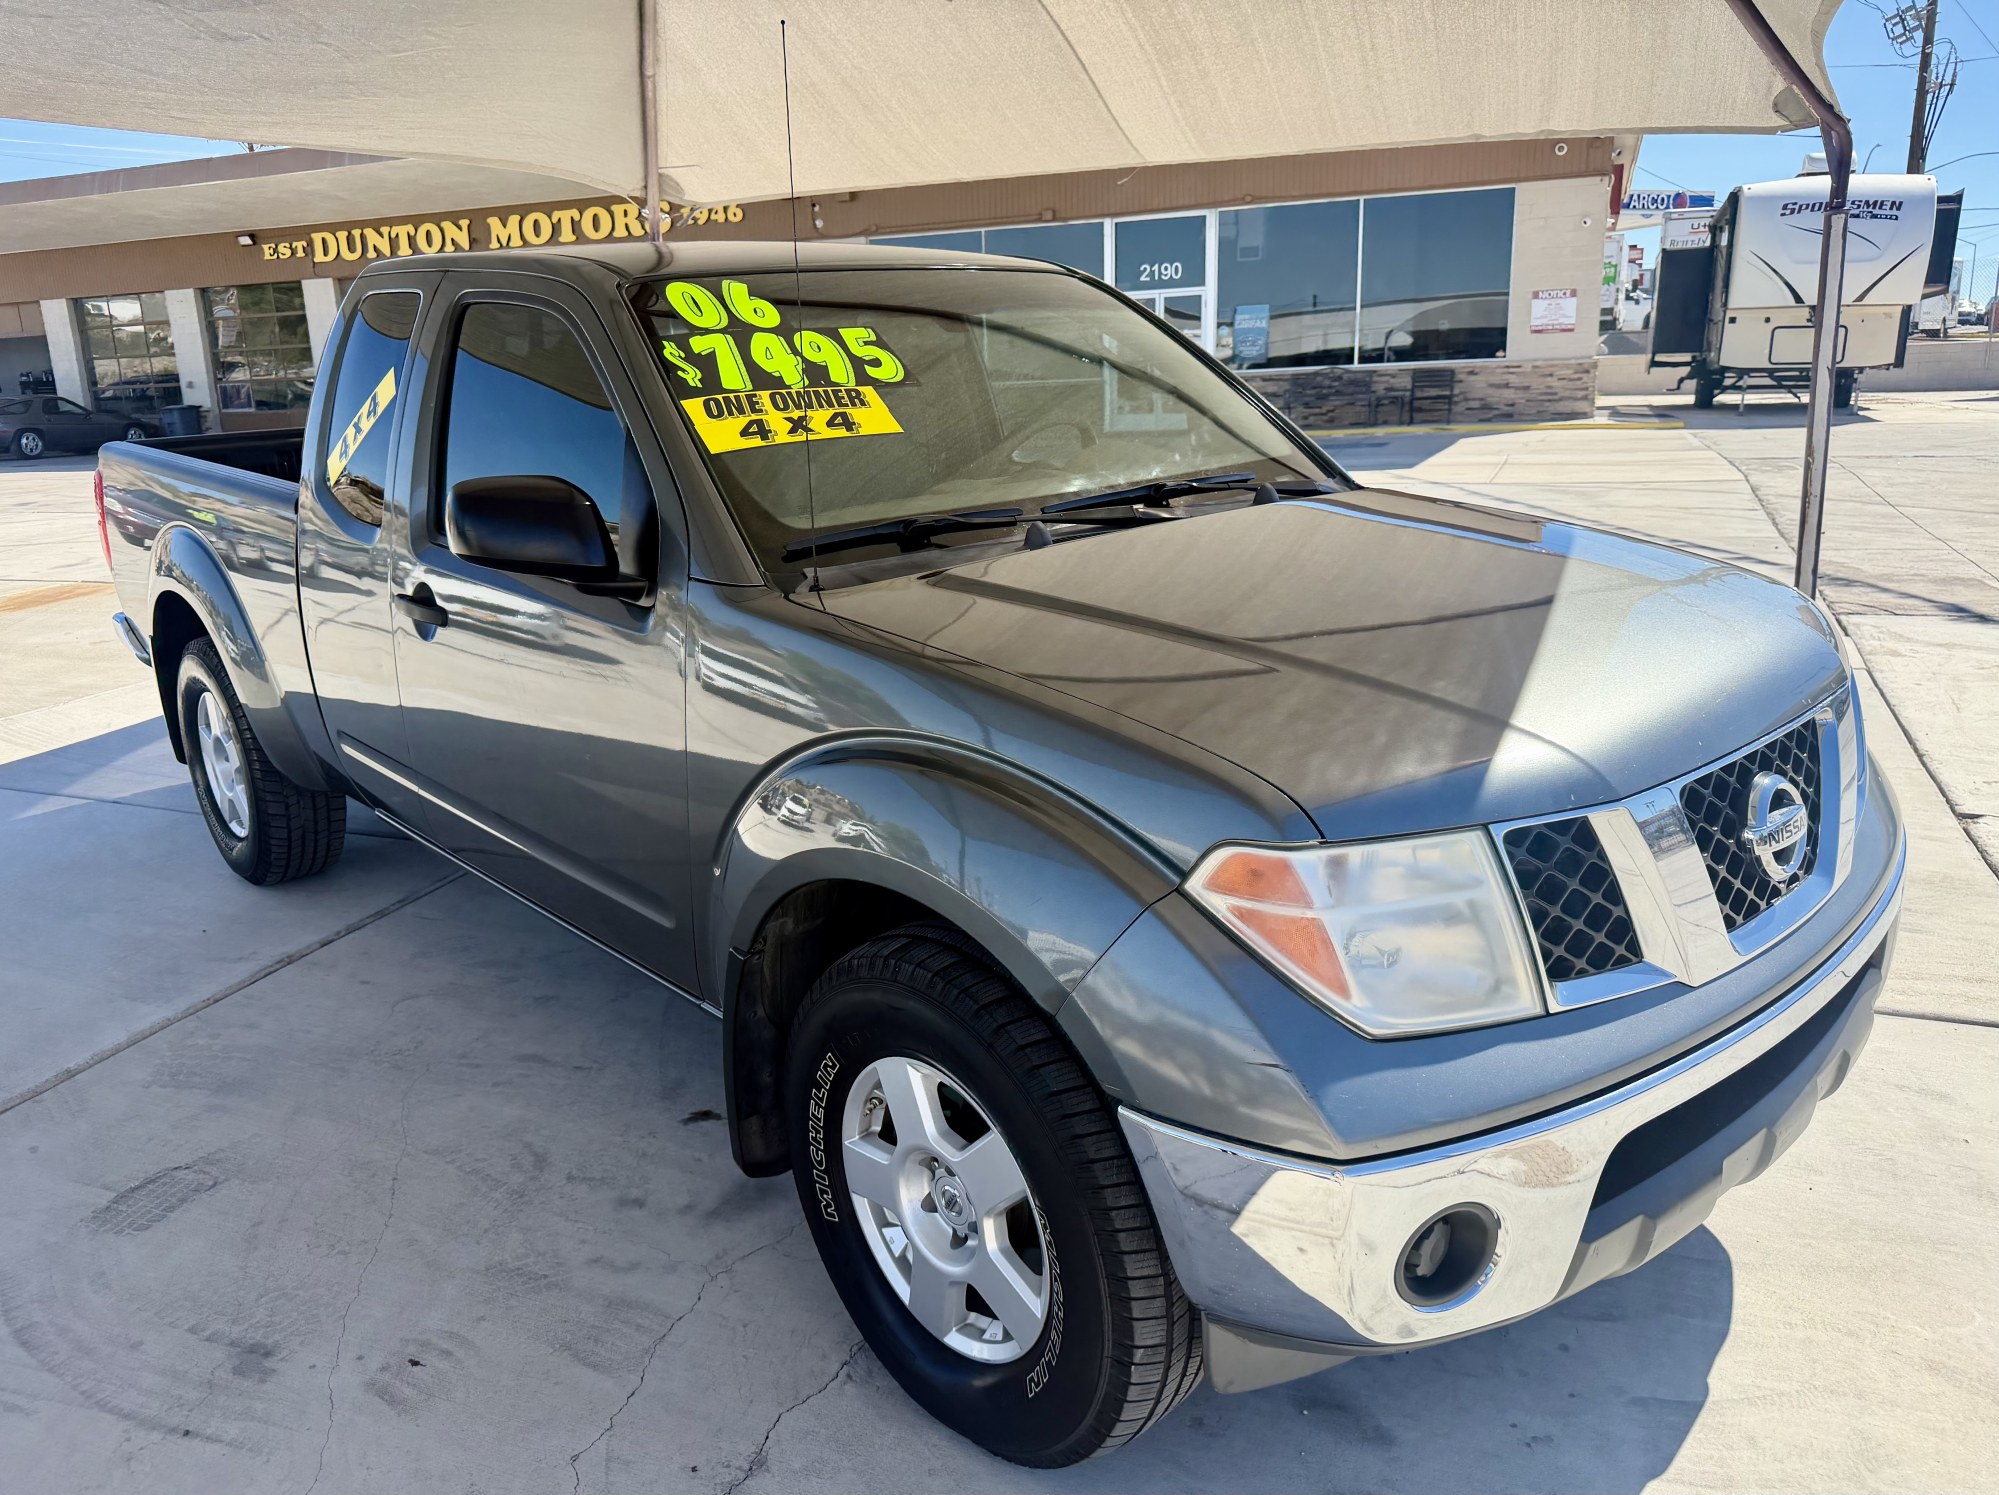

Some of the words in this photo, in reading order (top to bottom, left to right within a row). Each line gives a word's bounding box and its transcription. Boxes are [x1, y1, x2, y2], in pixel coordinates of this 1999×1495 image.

[1630, 193, 1668, 209] ARCO
[1780, 199, 1904, 217] SPOSMEN
[262, 241, 307, 260] EST
[311, 218, 471, 263] DUNTON
[1139, 261, 1183, 281] 2190
[665, 279, 781, 330] 06
[661, 327, 905, 391] $7495
[702, 392, 769, 420] ONE
[768, 387, 872, 413] OWNER
[1767, 815, 1806, 848] NISSA
[809, 1052, 840, 1221] MICHELIN
